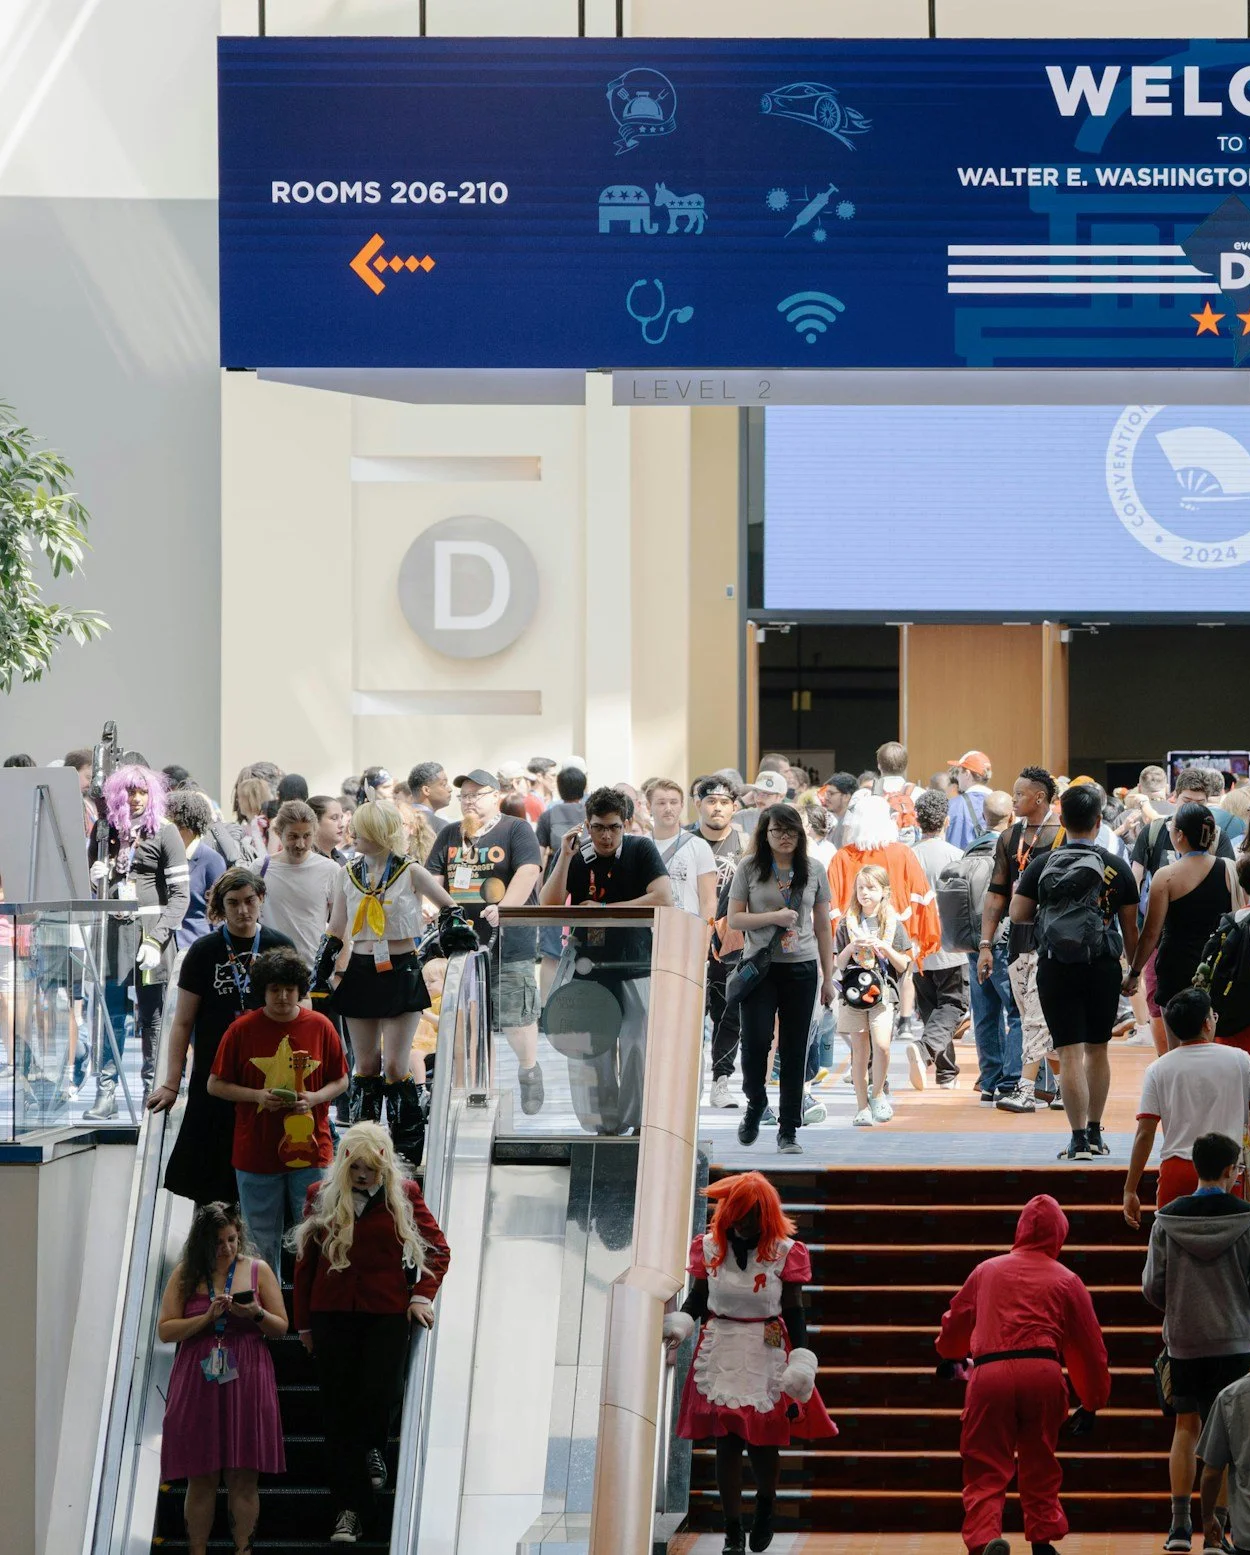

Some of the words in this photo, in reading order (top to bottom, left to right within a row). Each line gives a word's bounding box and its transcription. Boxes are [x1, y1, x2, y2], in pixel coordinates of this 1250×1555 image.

[1216, 136, 1243, 152] TO
[957, 167, 1059, 187] WALTER
[1066, 167, 1088, 187] E.
[271, 181, 382, 204] ROOMS
[390, 181, 509, 204] 206-210
[632, 379, 736, 399] LEVEL
[758, 379, 772, 399] 2
[1181, 545, 1239, 563] 2024
[435, 540, 511, 630] D
[447, 845, 506, 865] PLUTO
[217, 987, 234, 995] LET
